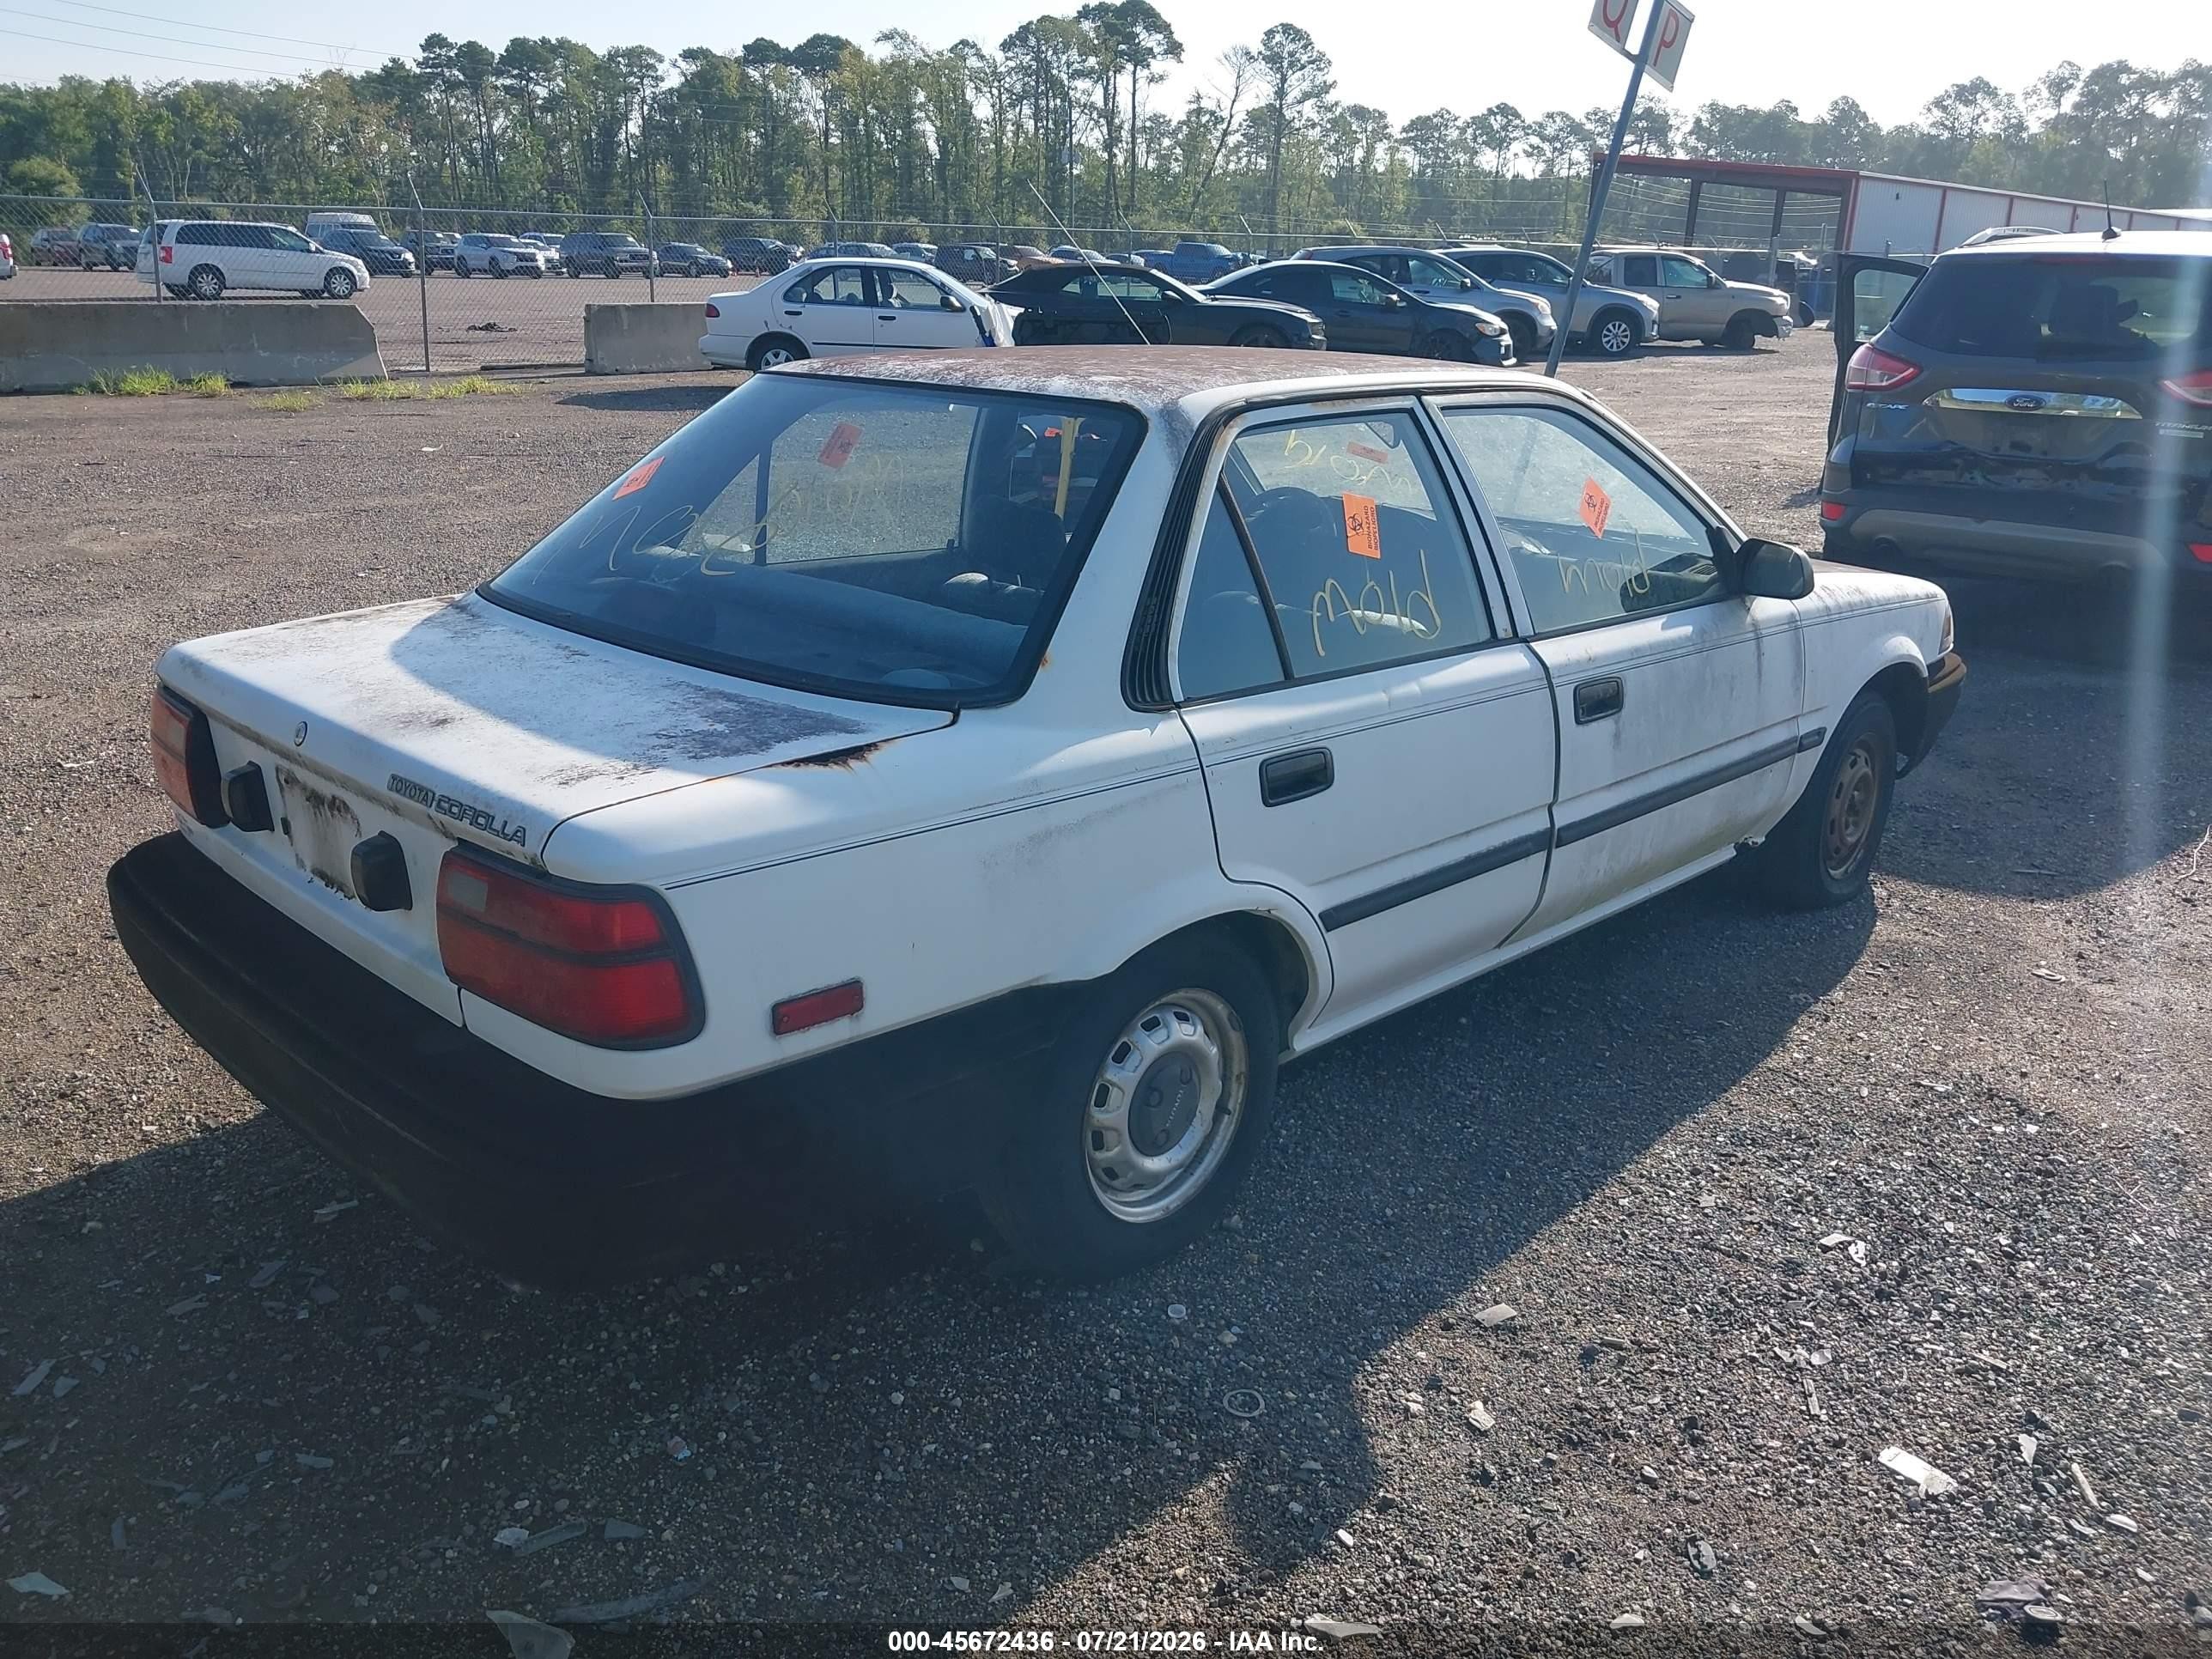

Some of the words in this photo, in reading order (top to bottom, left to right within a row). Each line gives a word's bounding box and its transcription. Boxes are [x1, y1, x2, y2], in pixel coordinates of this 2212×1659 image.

[1653, 9, 1679, 67] P
[2013, 398, 2036, 408] Ford
[1364, 505, 1372, 550] BIOHAZARD
[389, 775, 434, 808] TOYOTA
[434, 795, 526, 847] COROLLA
